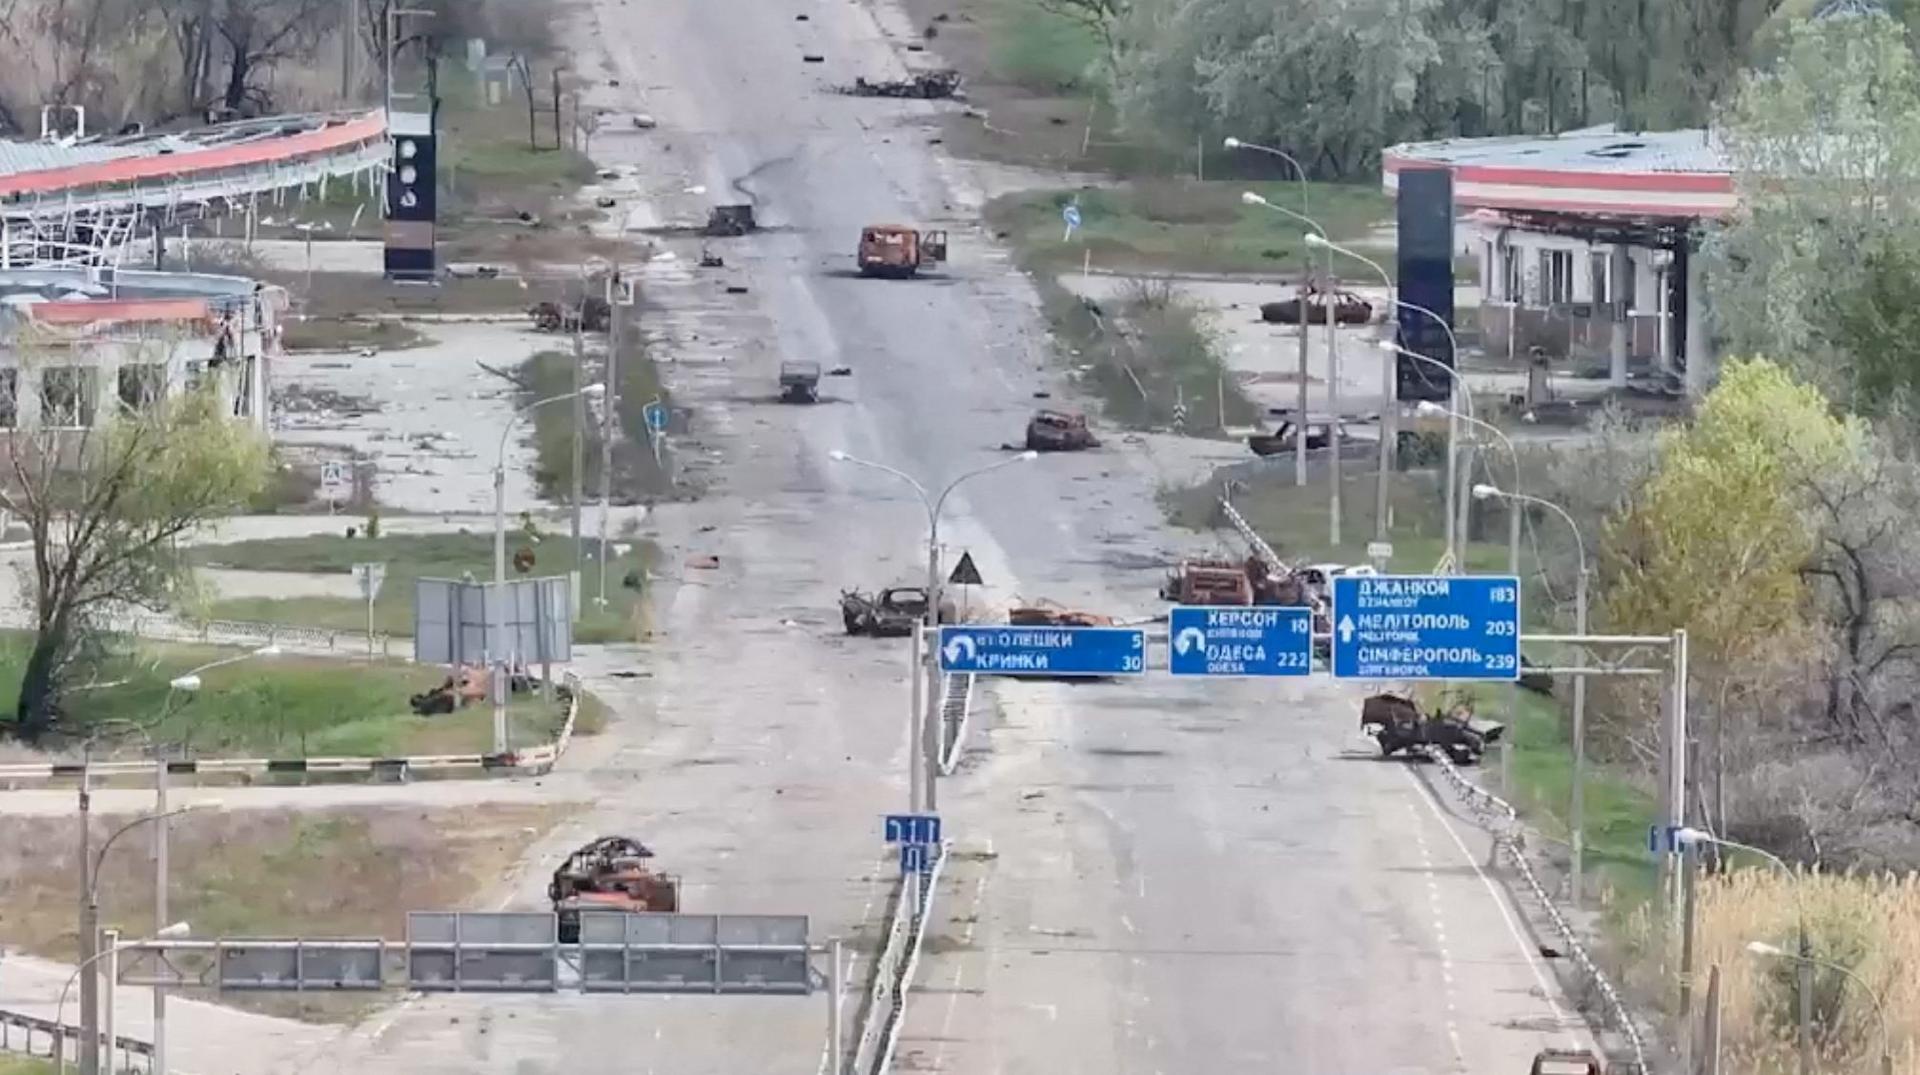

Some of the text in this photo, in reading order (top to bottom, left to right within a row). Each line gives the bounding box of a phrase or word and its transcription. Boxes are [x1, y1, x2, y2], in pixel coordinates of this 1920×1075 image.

[1358, 580, 1515, 603] ДЖАНКОЙ 183
[1207, 611, 1278, 627] ХЕРСОН
[1291, 618, 1308, 634] 10
[1358, 614, 1515, 636] МЕЛІТОПОЛЬ 203
[998, 632, 1072, 648] ОЛЕШКИ
[1131, 635, 1141, 647] 5
[1206, 645, 1266, 661] ОДЕСА
[1277, 652, 1308, 667] 222
[1358, 647, 1515, 669] СІМФЕРОПОЛЬ 239
[976, 653, 1141, 671] КРИНКИ 30
